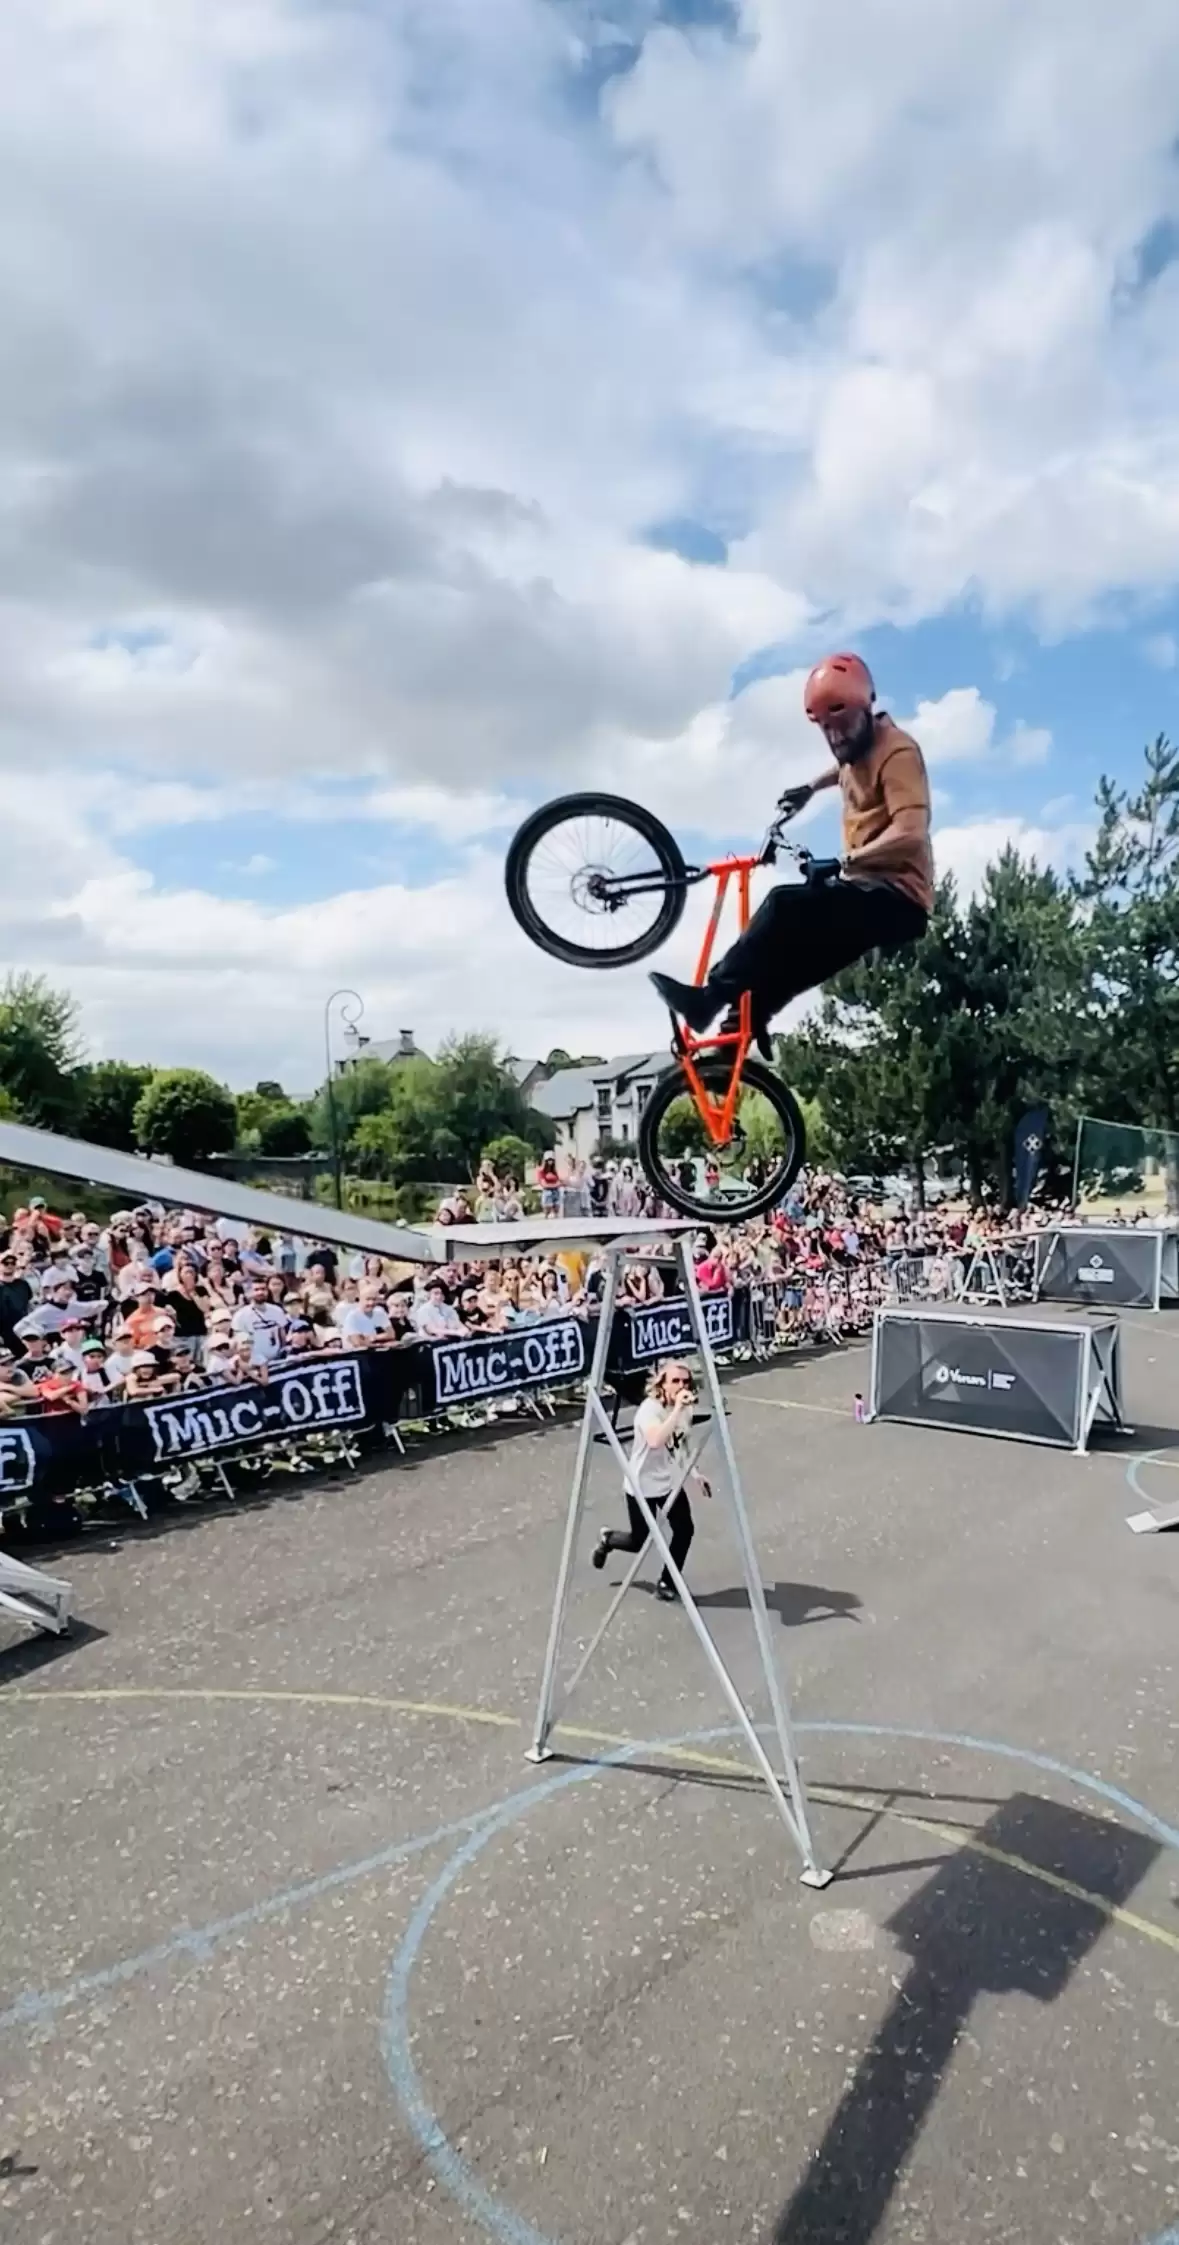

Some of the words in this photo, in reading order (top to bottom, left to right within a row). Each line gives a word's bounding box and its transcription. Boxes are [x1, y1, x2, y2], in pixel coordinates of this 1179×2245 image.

[637, 1303, 728, 1351] Muc-ff
[442, 1328, 578, 1393] Muc-Off
[161, 1368, 355, 1452] Muc-Off
